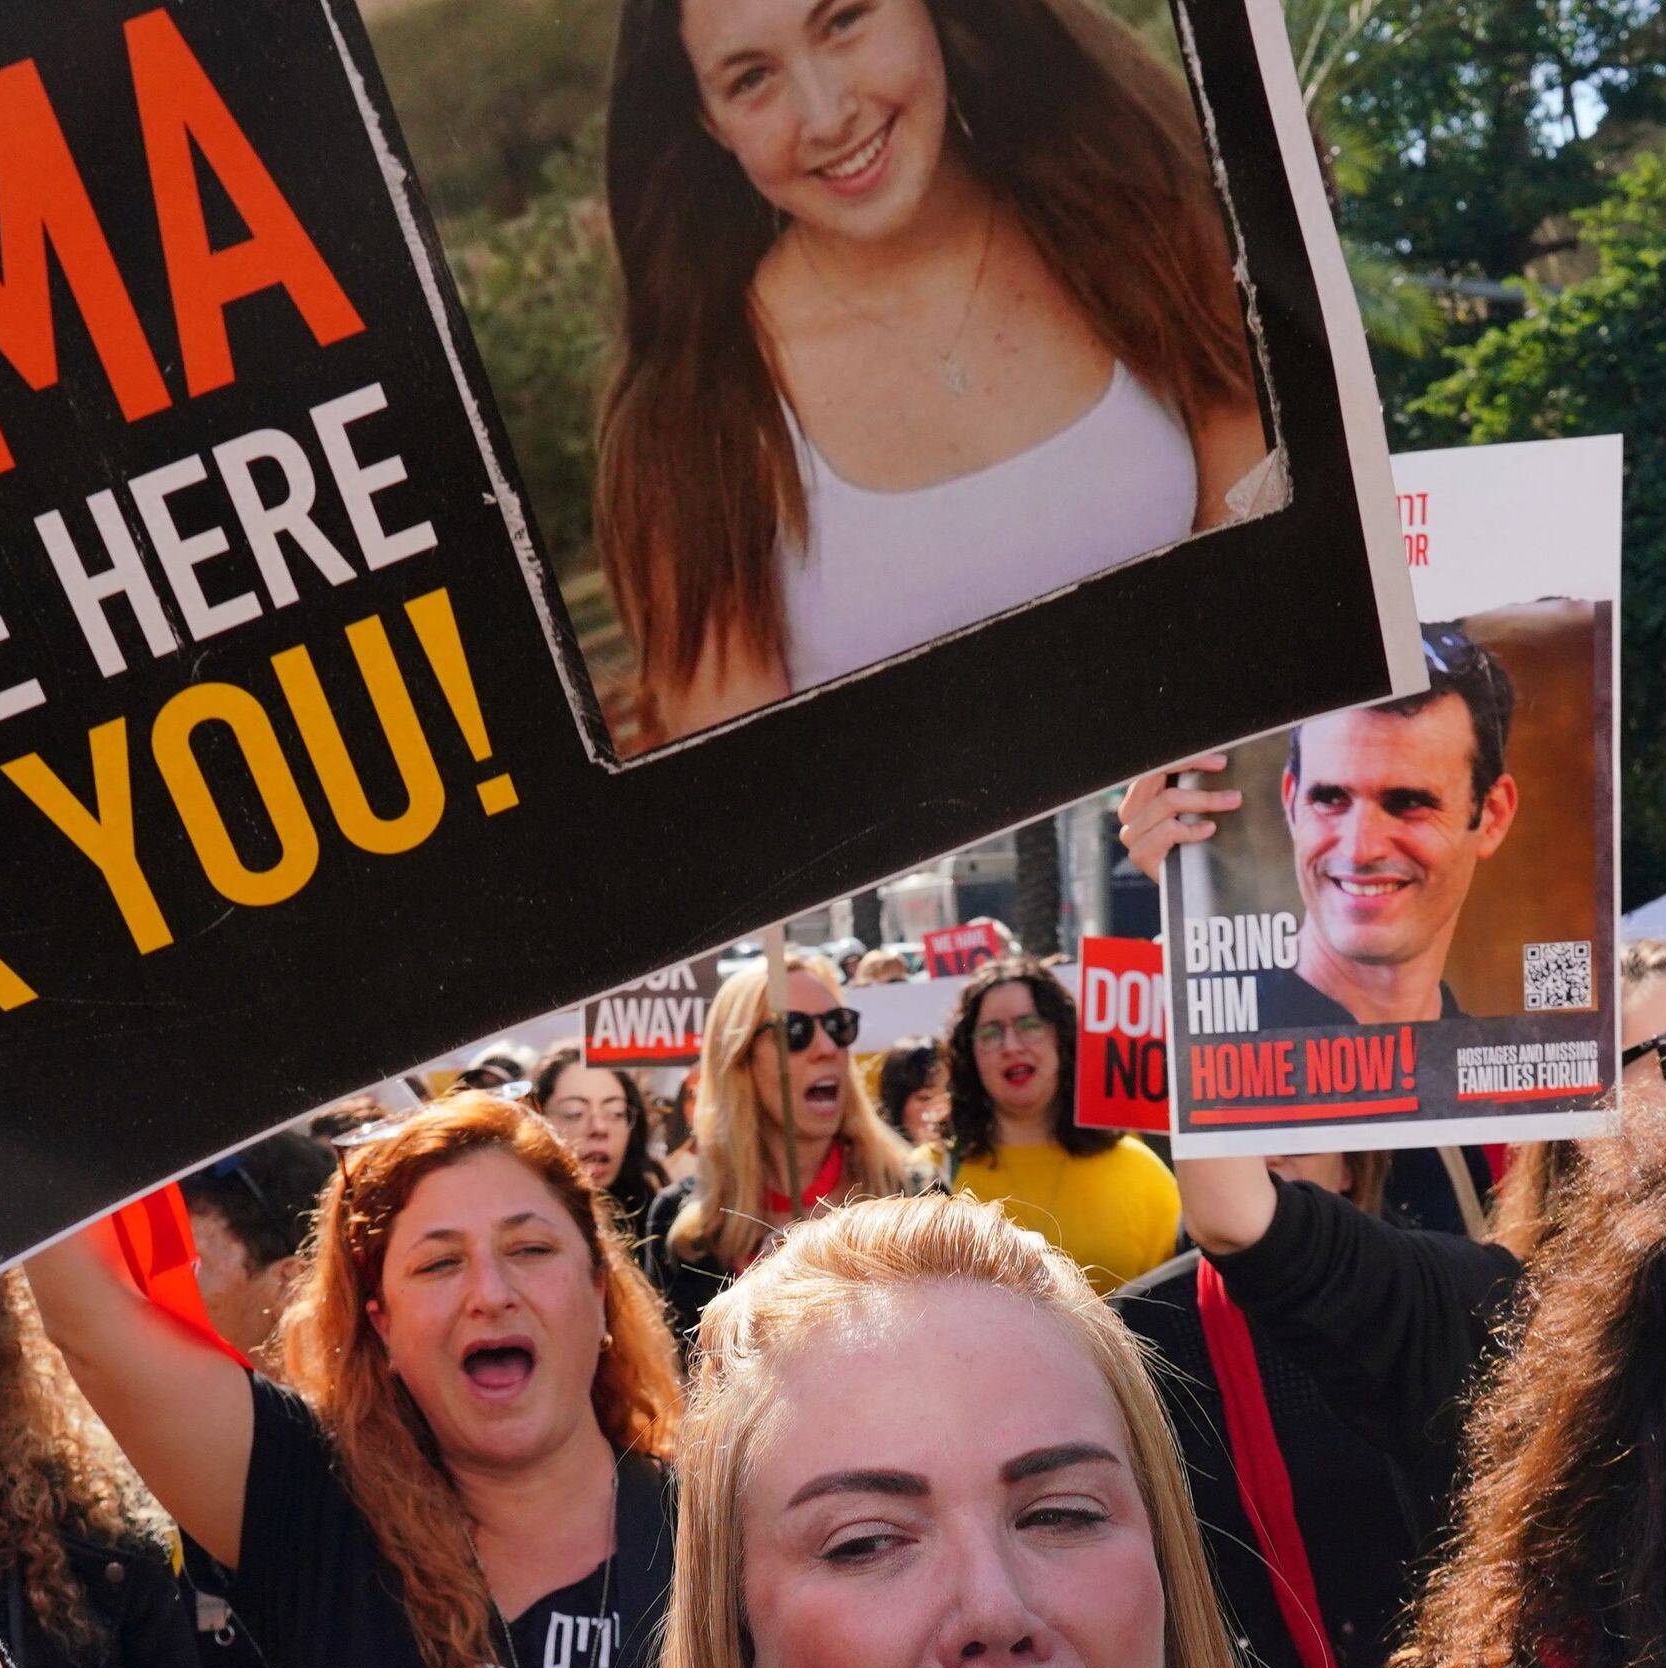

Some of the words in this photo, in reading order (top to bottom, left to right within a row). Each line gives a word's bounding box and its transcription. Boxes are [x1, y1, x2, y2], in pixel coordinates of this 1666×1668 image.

[34, 382, 437, 680] HERE
[0, 587, 520, 957] YOU!
[1186, 911, 1300, 973] BRING
[592, 997, 704, 1049] AWAY!
[1188, 977, 1259, 1035] HIM
[1190, 1040, 1296, 1101] HOME
[1307, 1026, 1417, 1096] NOW!
[1457, 1047, 1517, 1064] HOSTAGES
[1519, 1045, 1543, 1062] AND
[1545, 1041, 1598, 1061] MISSING
[1457, 1063, 1535, 1093] FAMILIES
[1537, 1061, 1598, 1089] FORUM
